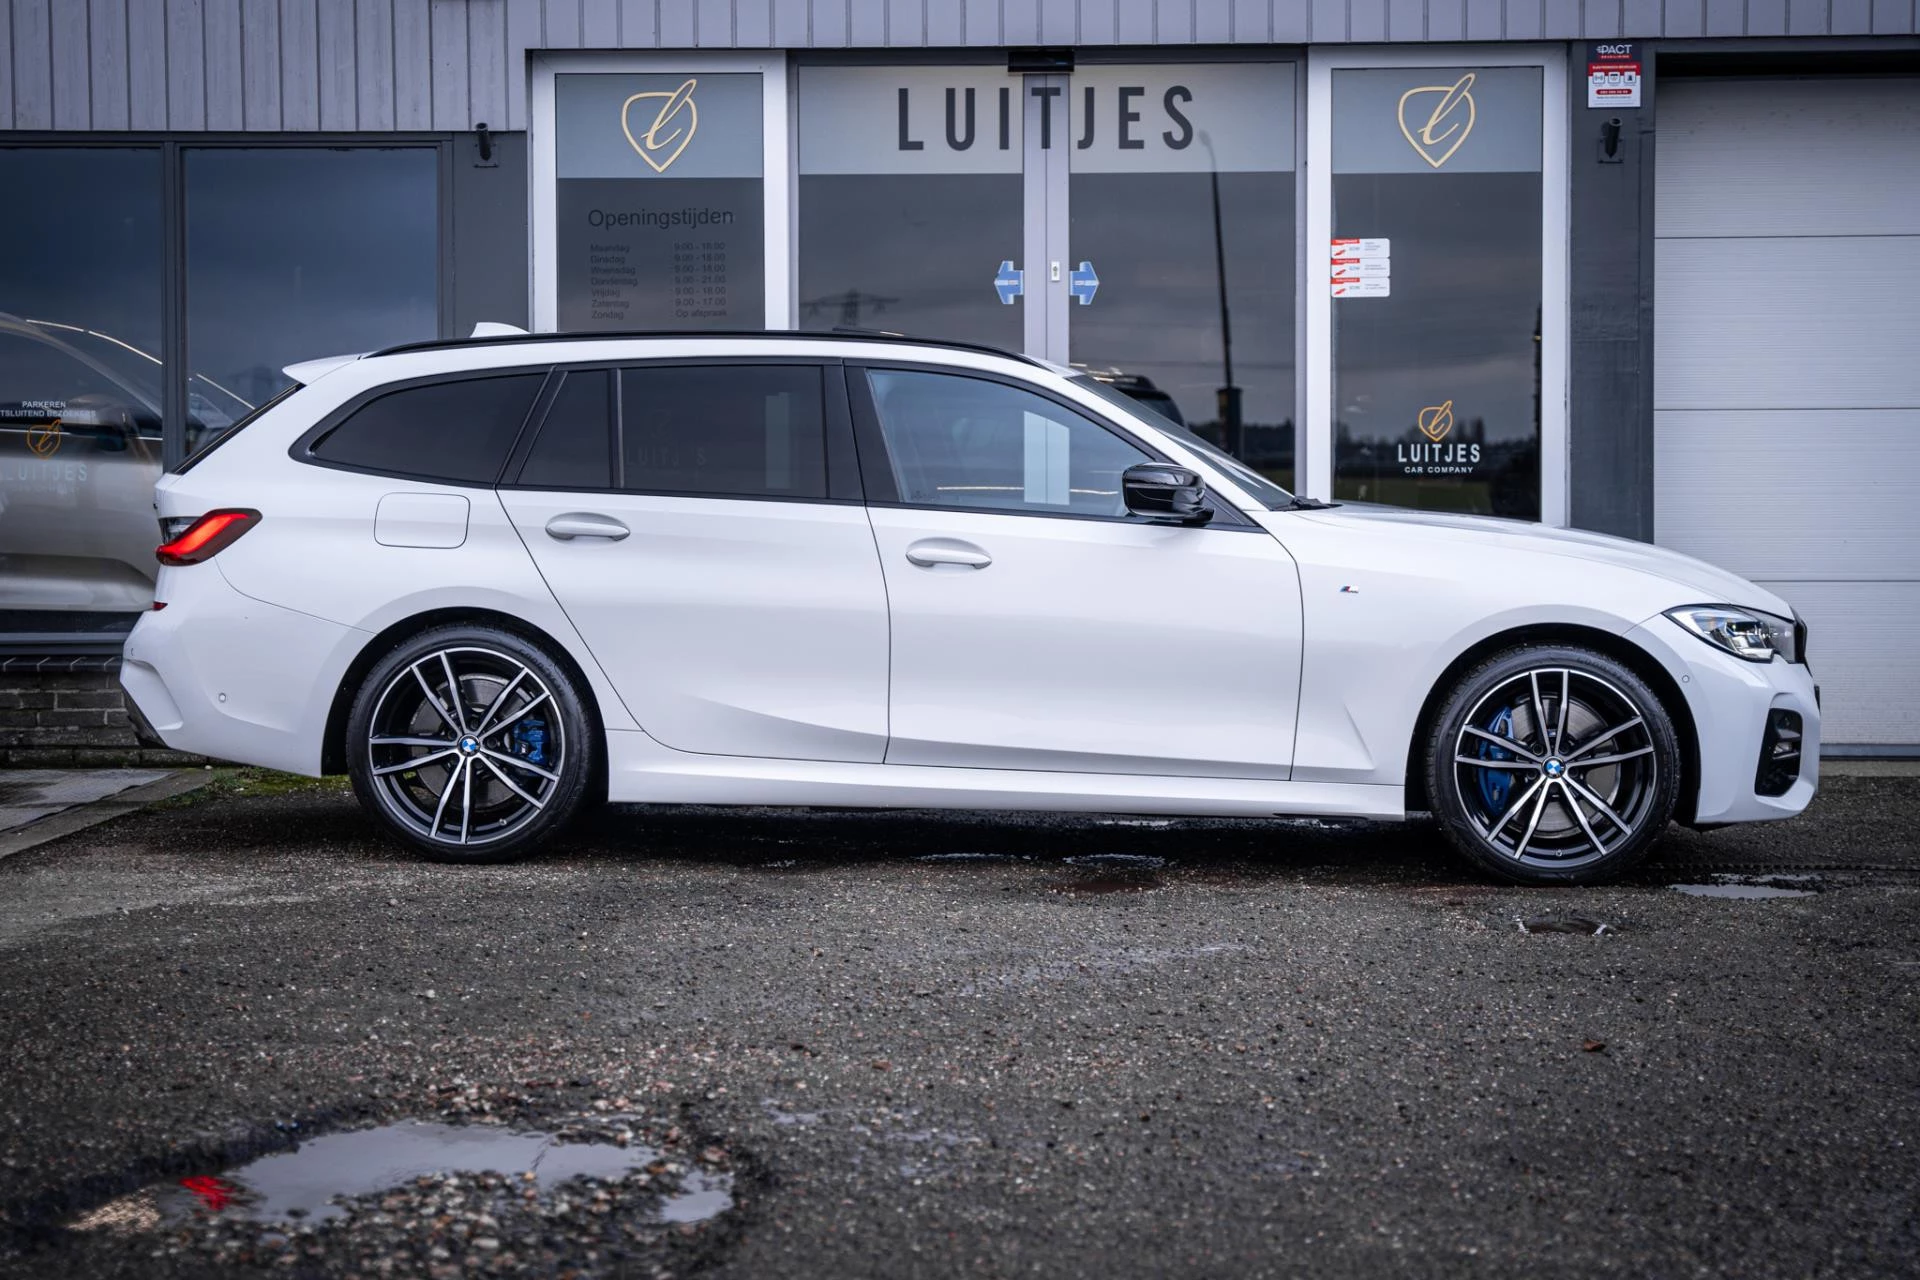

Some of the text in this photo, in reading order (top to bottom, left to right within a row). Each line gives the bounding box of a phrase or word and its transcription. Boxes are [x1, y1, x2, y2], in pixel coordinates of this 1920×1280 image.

[898, 85, 1194, 152] LUITJES
[588, 208, 735, 231] Openingstijden
[591, 310, 624, 320] Zondag
[22, 400, 66, 408] PARKEREN
[1397, 443, 1480, 463] LUITJES
